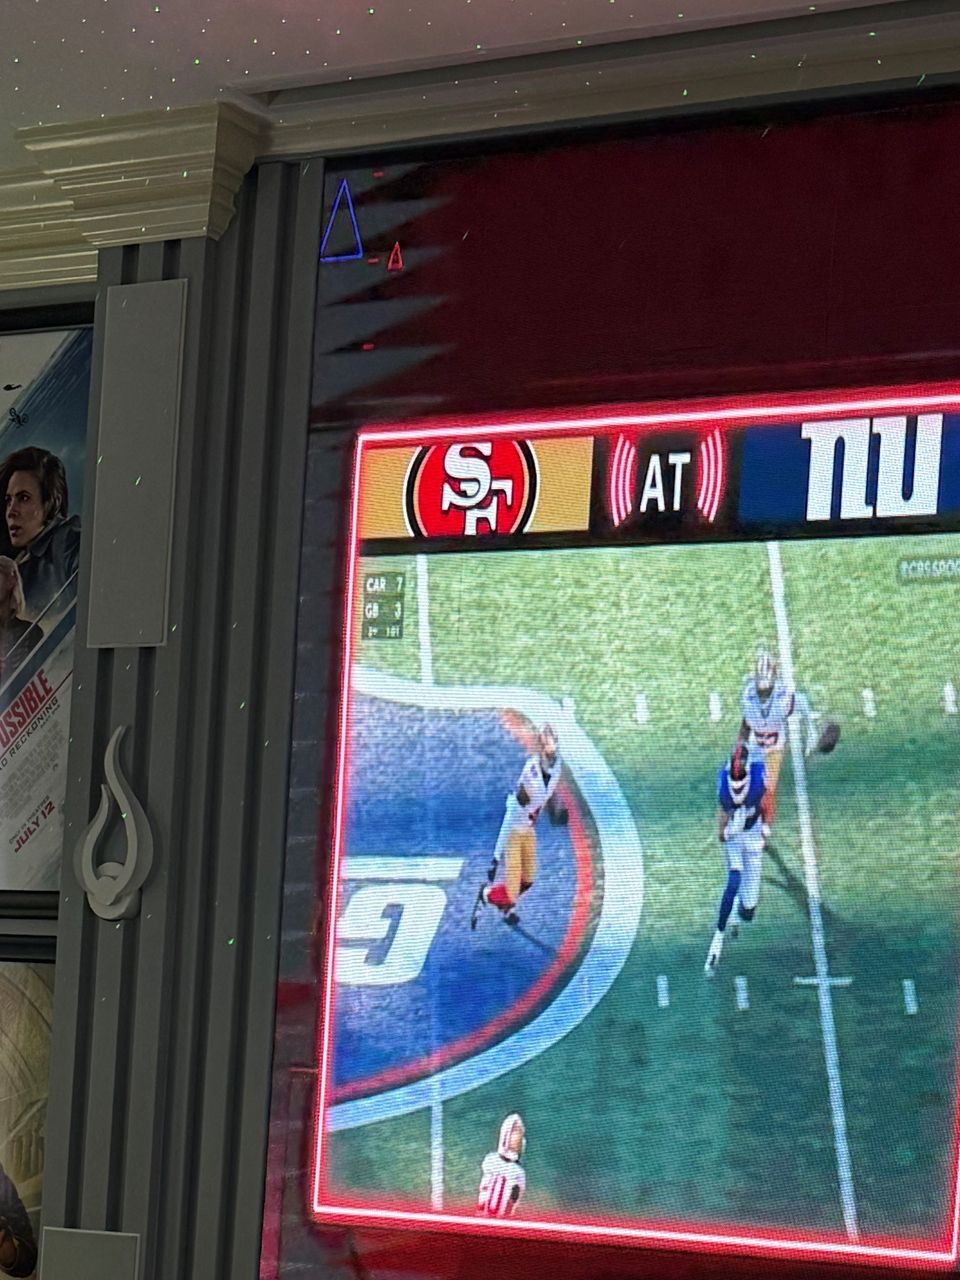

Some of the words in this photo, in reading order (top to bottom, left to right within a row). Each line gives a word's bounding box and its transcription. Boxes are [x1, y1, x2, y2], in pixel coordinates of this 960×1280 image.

[639, 452, 691, 513] AT
[366, 577, 386, 592] CAR
[396, 576, 403, 592] 7
[9, 696, 58, 757] RECKONING
[15, 816, 40, 853] JULY
[41, 801, 55, 819] 12
